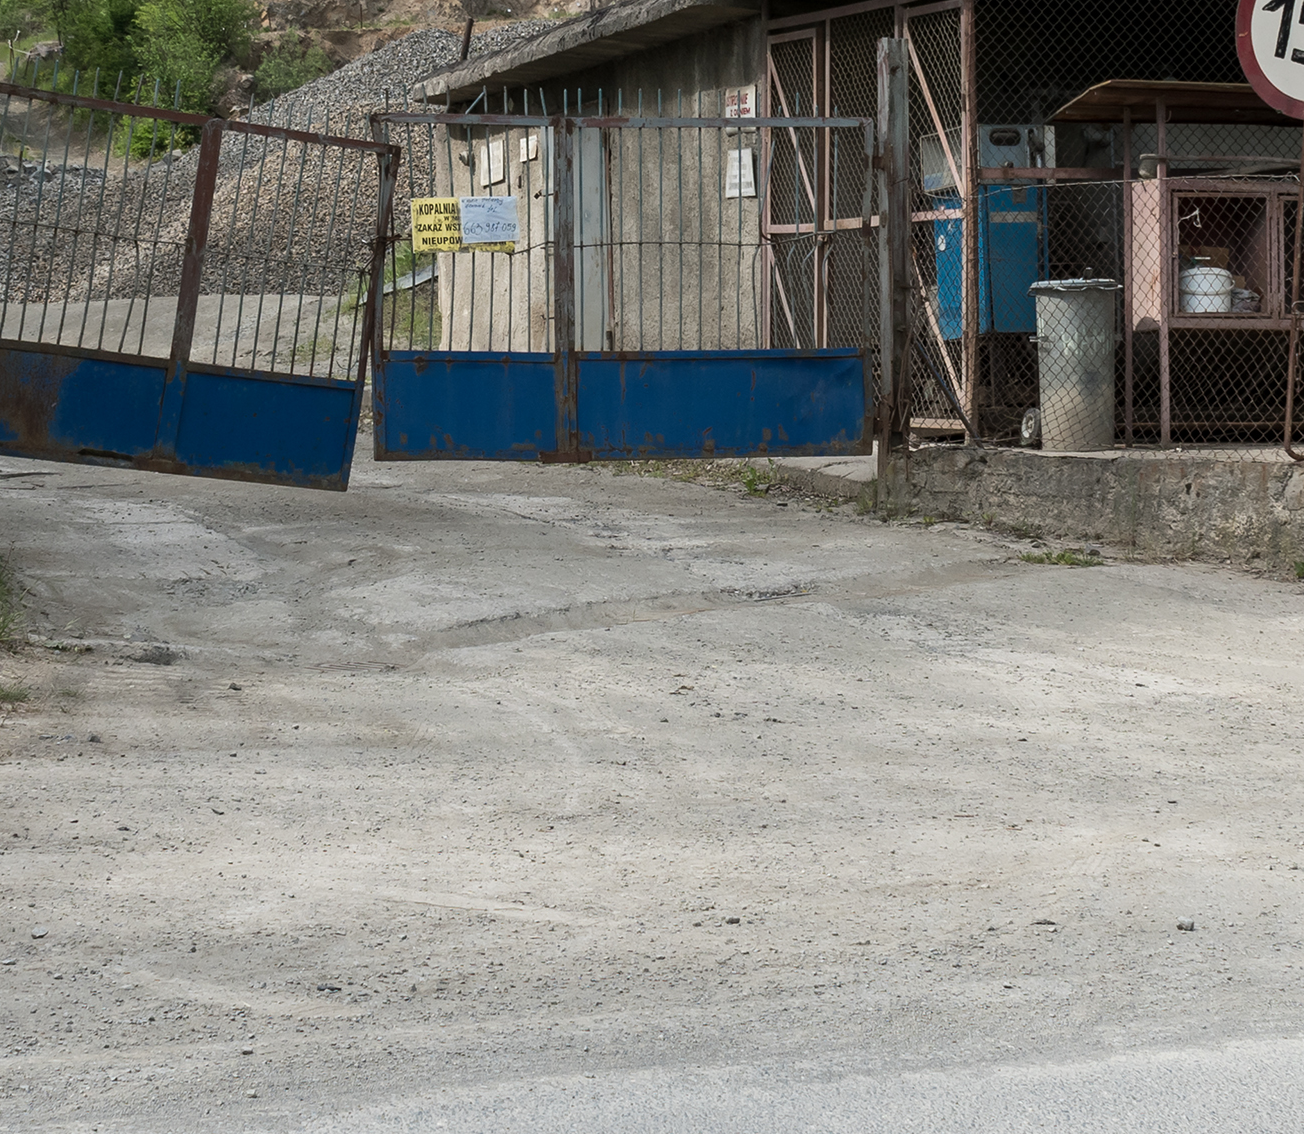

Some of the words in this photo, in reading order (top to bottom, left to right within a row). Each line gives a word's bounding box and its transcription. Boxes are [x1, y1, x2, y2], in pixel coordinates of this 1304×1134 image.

[418, 203, 456, 215] KOPALNIA
[445, 223, 461, 232] WST
[422, 236, 463, 245] NIEUPOW
